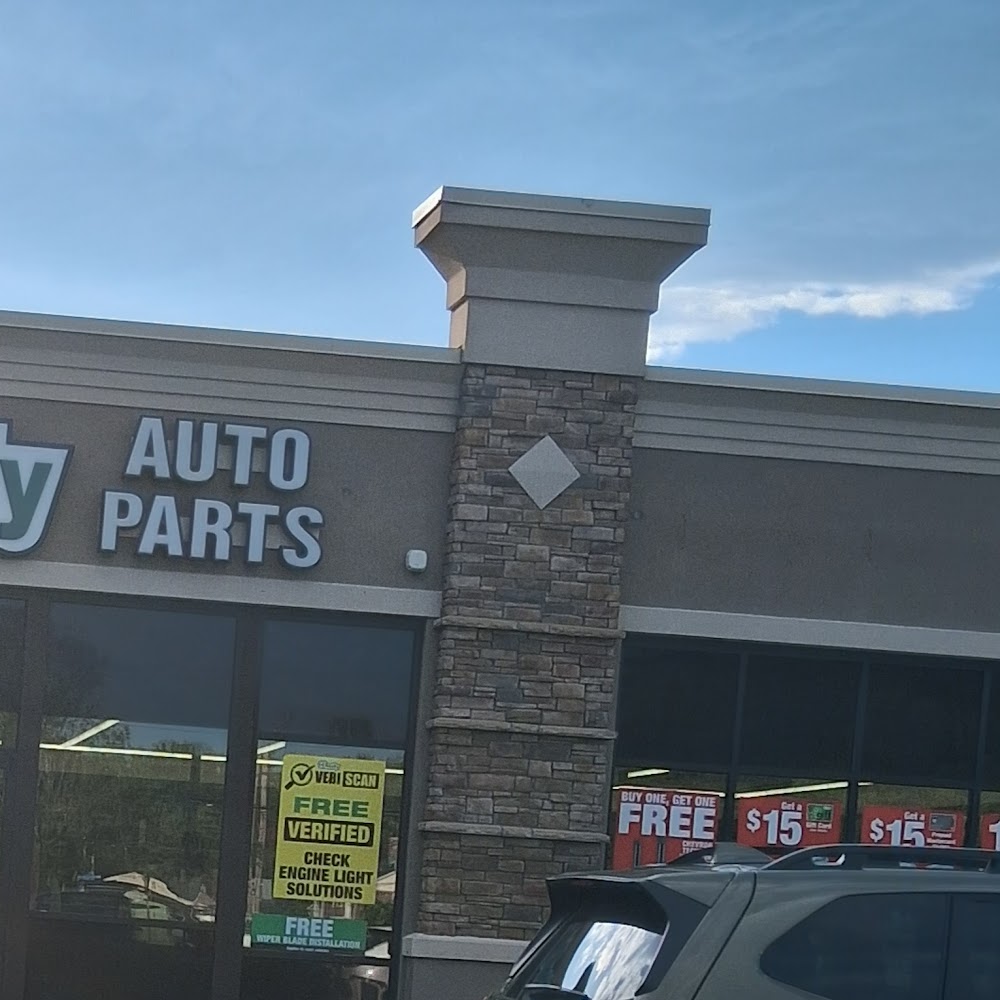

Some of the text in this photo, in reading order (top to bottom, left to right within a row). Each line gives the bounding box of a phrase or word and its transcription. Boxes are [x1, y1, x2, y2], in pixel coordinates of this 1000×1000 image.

[125, 417, 311, 490] AUTO
[101, 491, 324, 568] PARTS
[293, 796, 369, 818] FREE
[621, 791, 717, 808] BUY ONE, GET ONE
[781, 801, 795, 810] Get
[618, 802, 717, 840] FREE
[904, 811, 918, 821] Get
[287, 820, 371, 844] VERIFIED
[746, 808, 803, 846] $15
[869, 817, 926, 847] $15
[304, 851, 350, 867] CHECK
[279, 866, 374, 885] ENGINE LIGHT
[286, 882, 363, 900] SOLUTIONS
[285, 917, 334, 938] FREE
[256, 934, 361, 949] WIPER BLADE INSTALLATION
